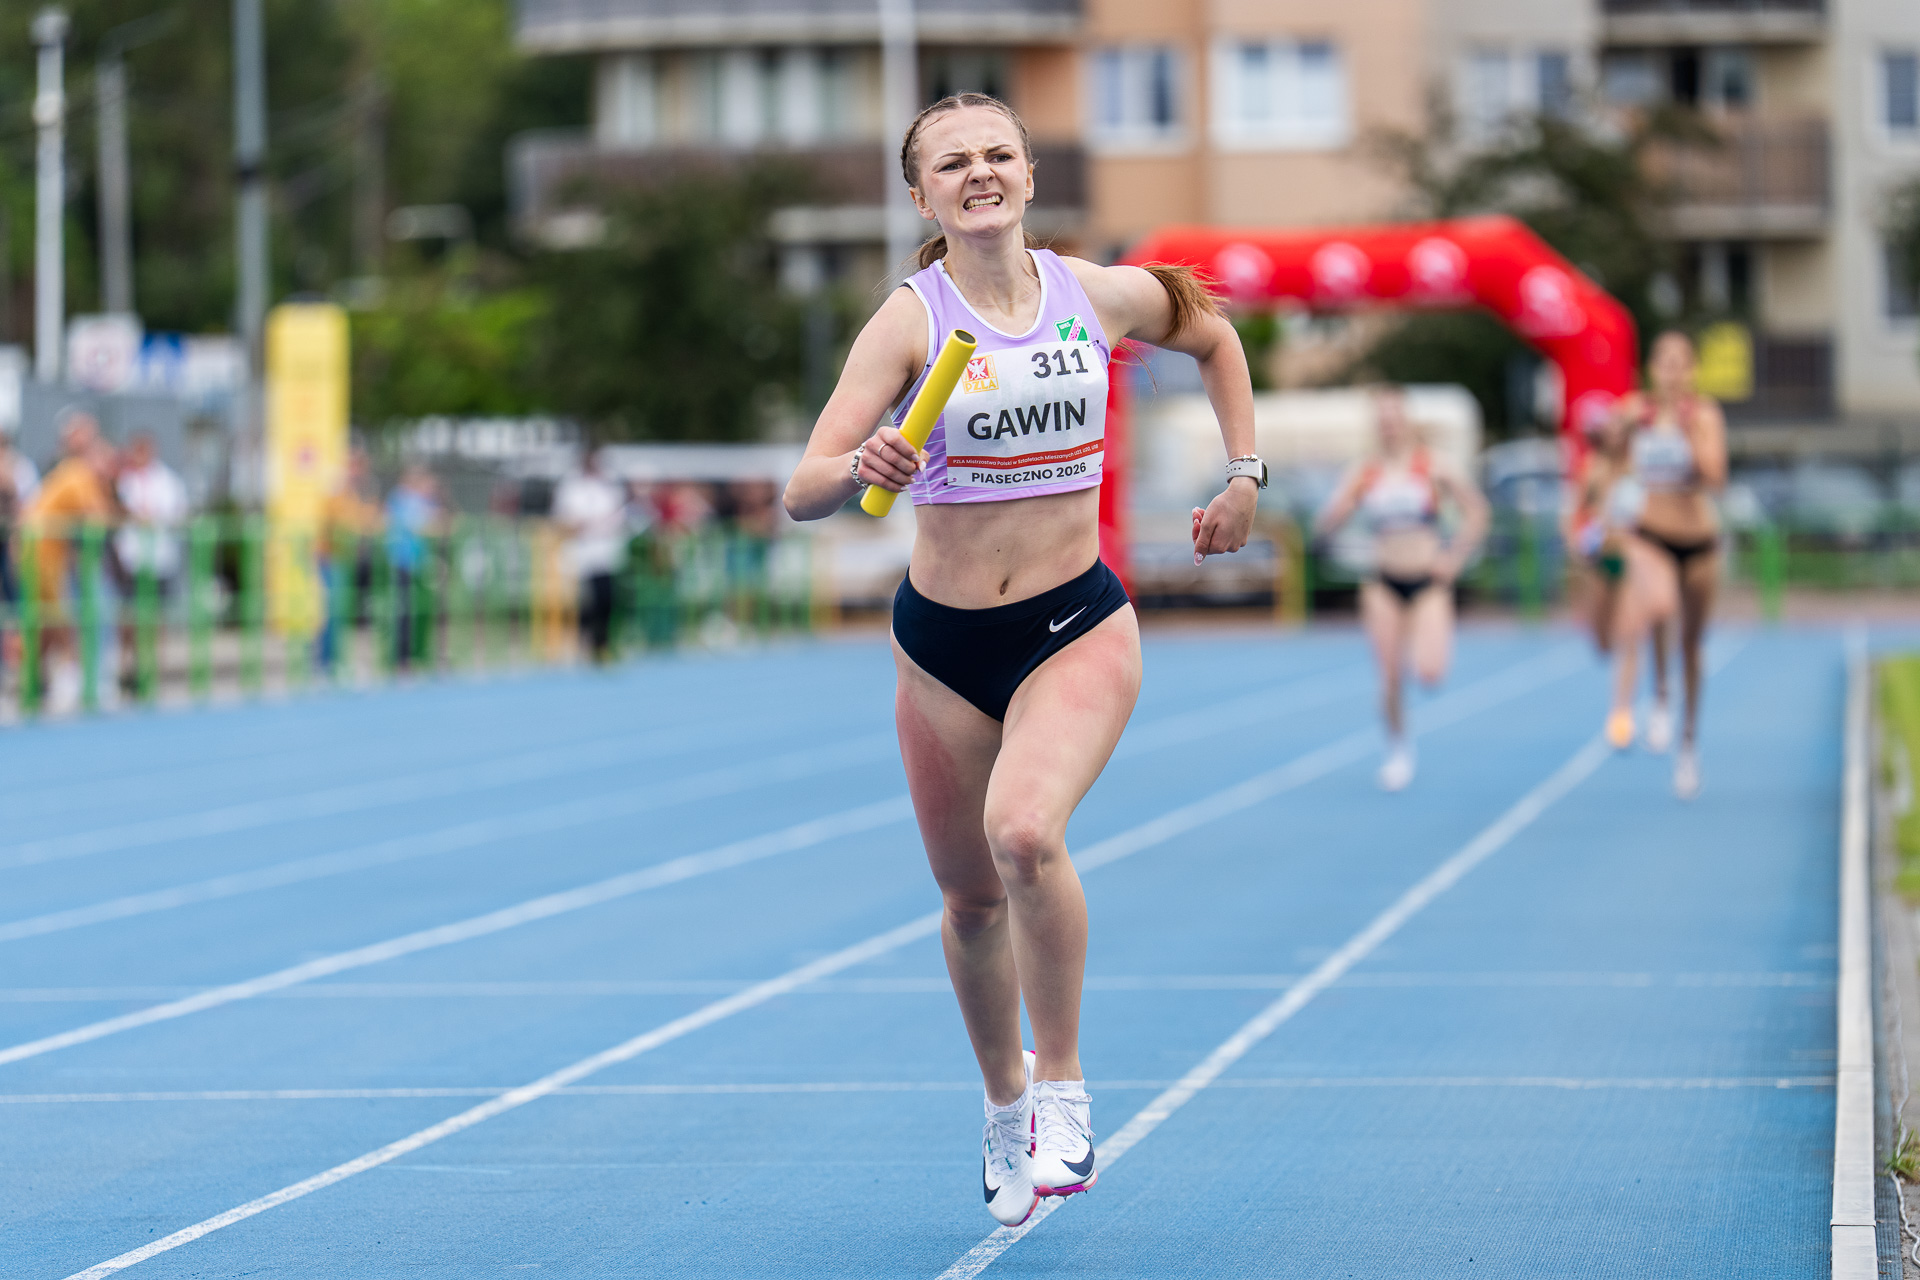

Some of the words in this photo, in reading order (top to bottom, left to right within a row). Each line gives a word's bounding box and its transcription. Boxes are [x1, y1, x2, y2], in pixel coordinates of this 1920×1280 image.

[1031, 348, 1089, 379] 311
[965, 380, 997, 392] PZLA
[967, 397, 1086, 441] GAWIN
[1018, 456, 1044, 464] Sztafetach
[1045, 452, 1074, 460] Mieszanych
[971, 469, 1053, 484] PIASECZNO
[1056, 461, 1087, 478] 2026
